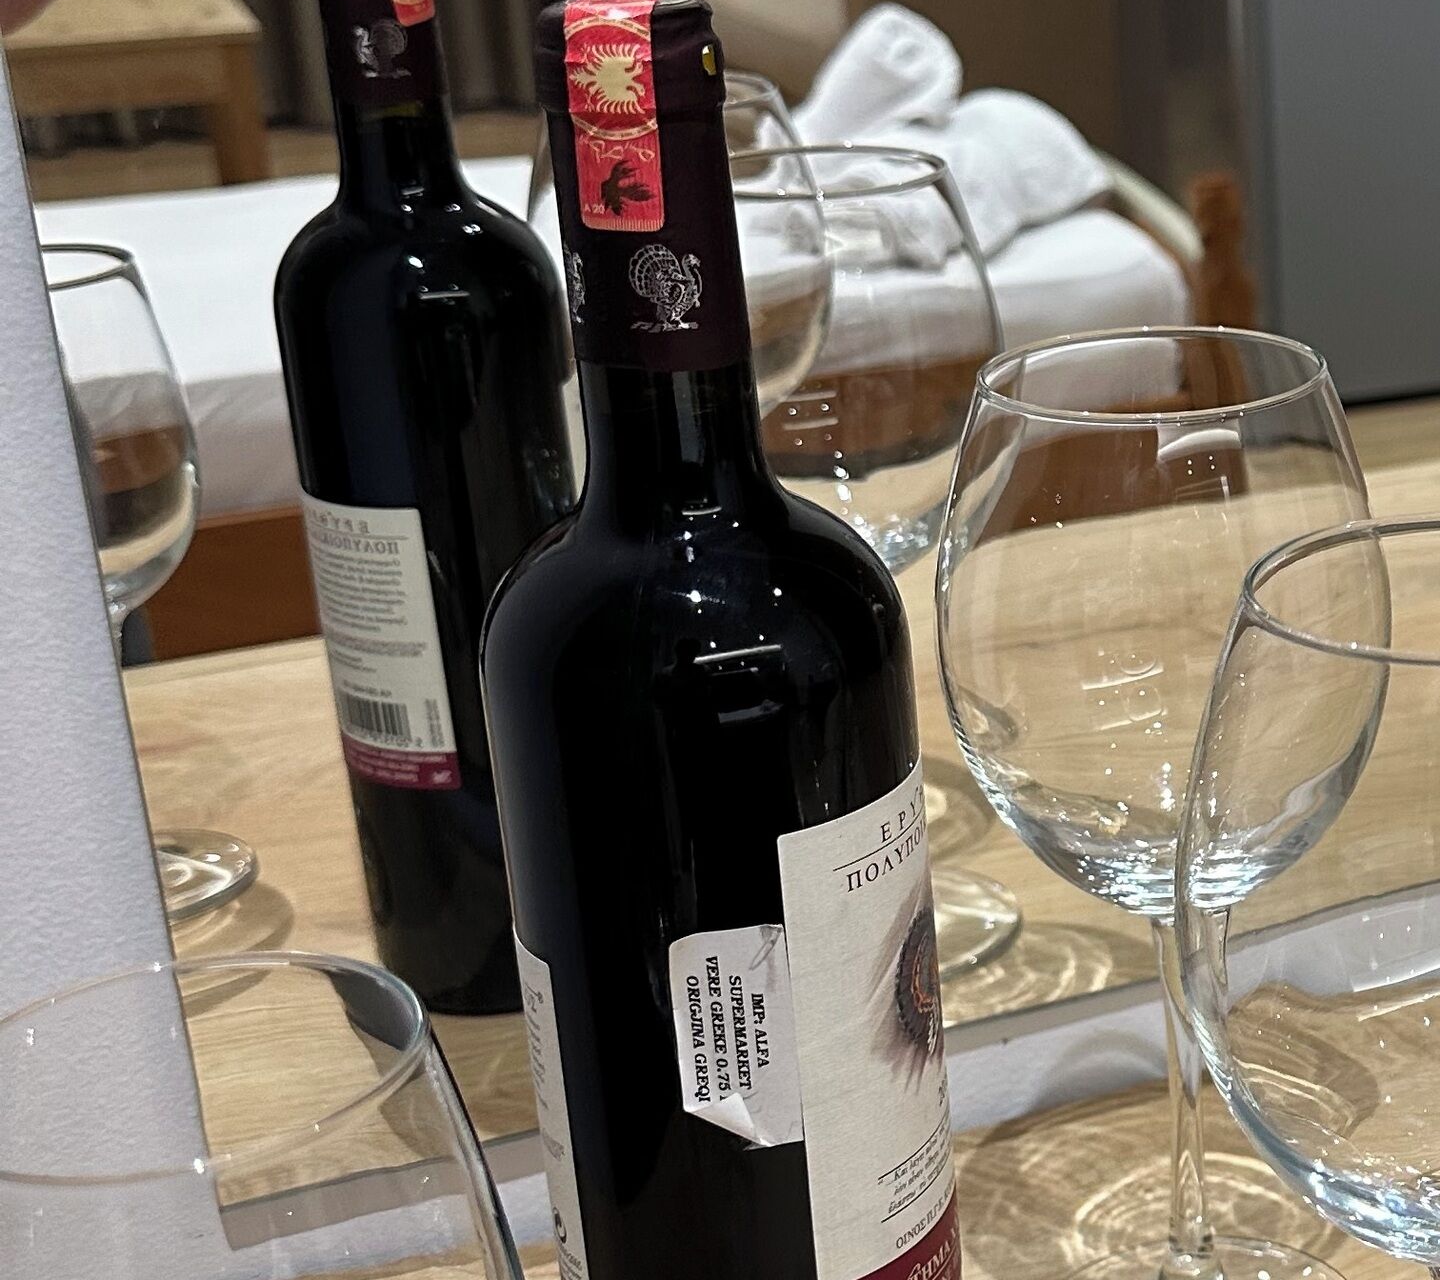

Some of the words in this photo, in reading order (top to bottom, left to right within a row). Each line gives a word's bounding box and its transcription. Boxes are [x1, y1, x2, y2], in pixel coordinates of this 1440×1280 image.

[706, 956, 722, 997] VERE
[687, 976, 705, 1049] ORIGJINA
[711, 1001, 727, 1054] GREKE
[751, 993, 765, 1025] IMP:
[729, 976, 752, 1090] SUPERMARKET
[755, 1029, 770, 1068] ALFA
[694, 1054, 710, 1102] GREQI
[716, 1058, 732, 1091] 0.75
